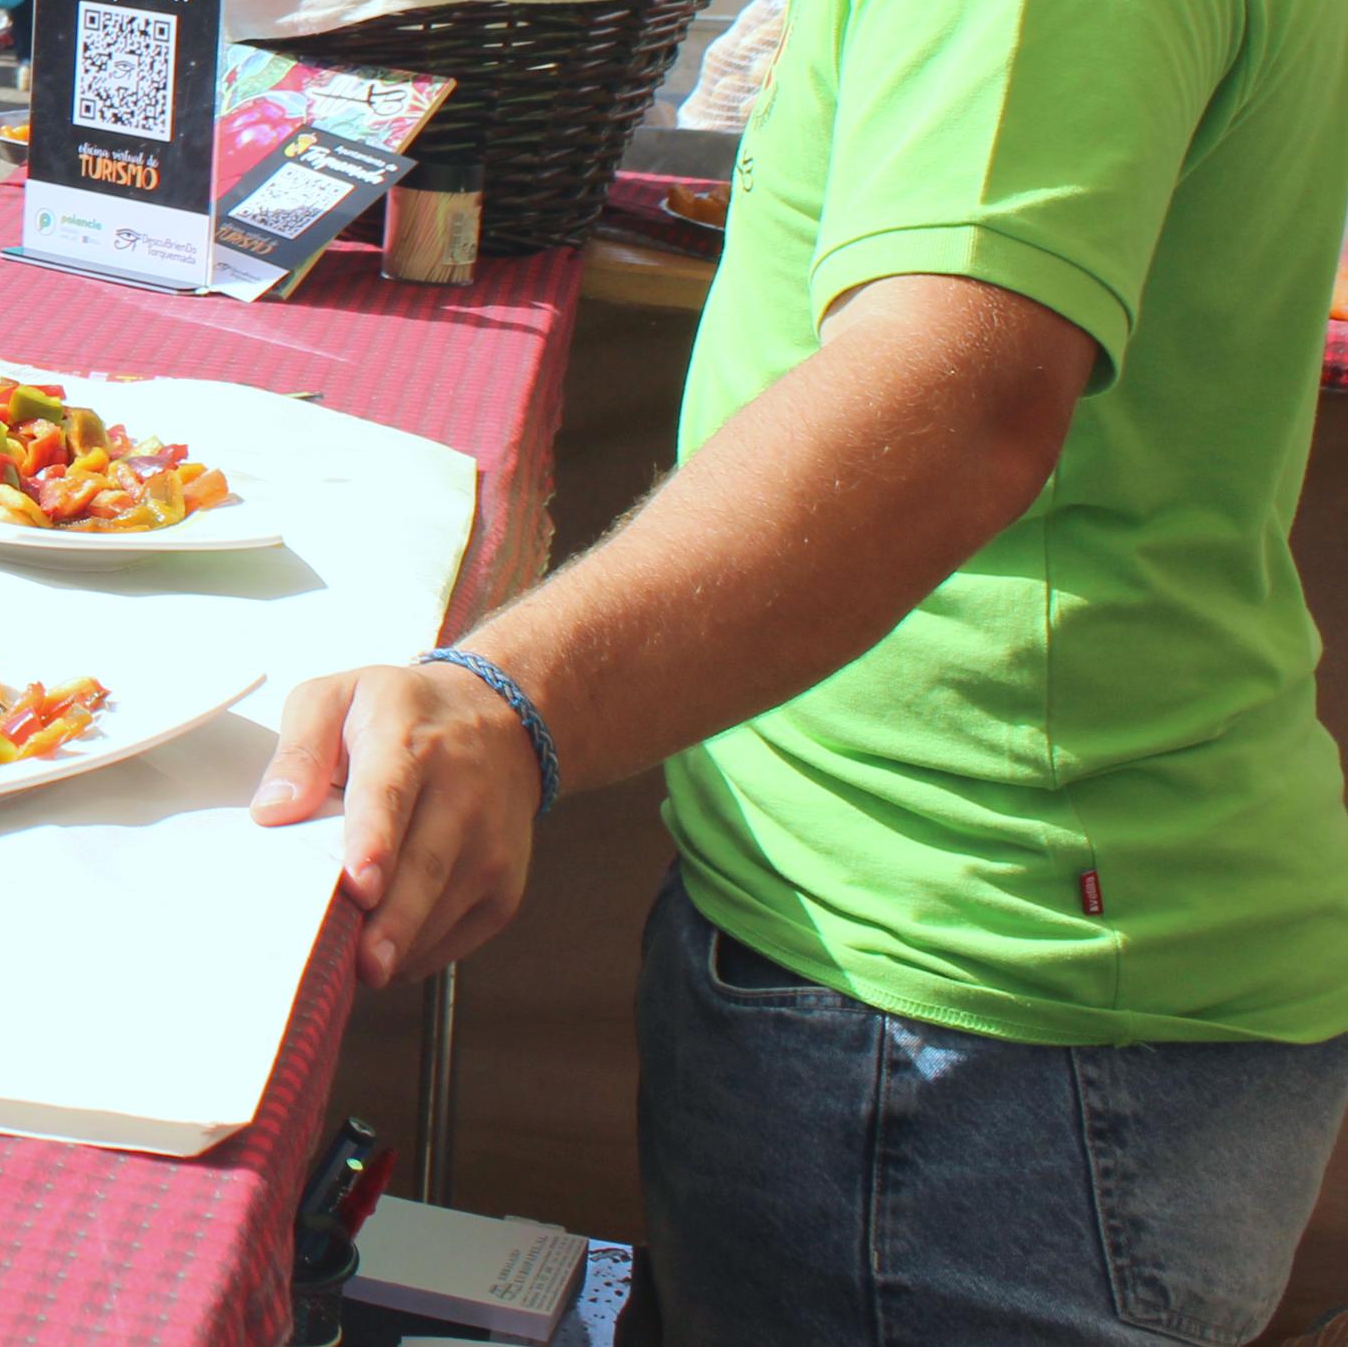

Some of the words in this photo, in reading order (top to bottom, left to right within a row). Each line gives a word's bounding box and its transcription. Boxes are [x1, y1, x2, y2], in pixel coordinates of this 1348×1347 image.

[78, 142, 110, 157] oficina
[112, 150, 142, 163] virtual
[147, 154, 159, 168] de
[79, 154, 160, 190] TURISMO
[147, 247, 196, 265] Torquemada
